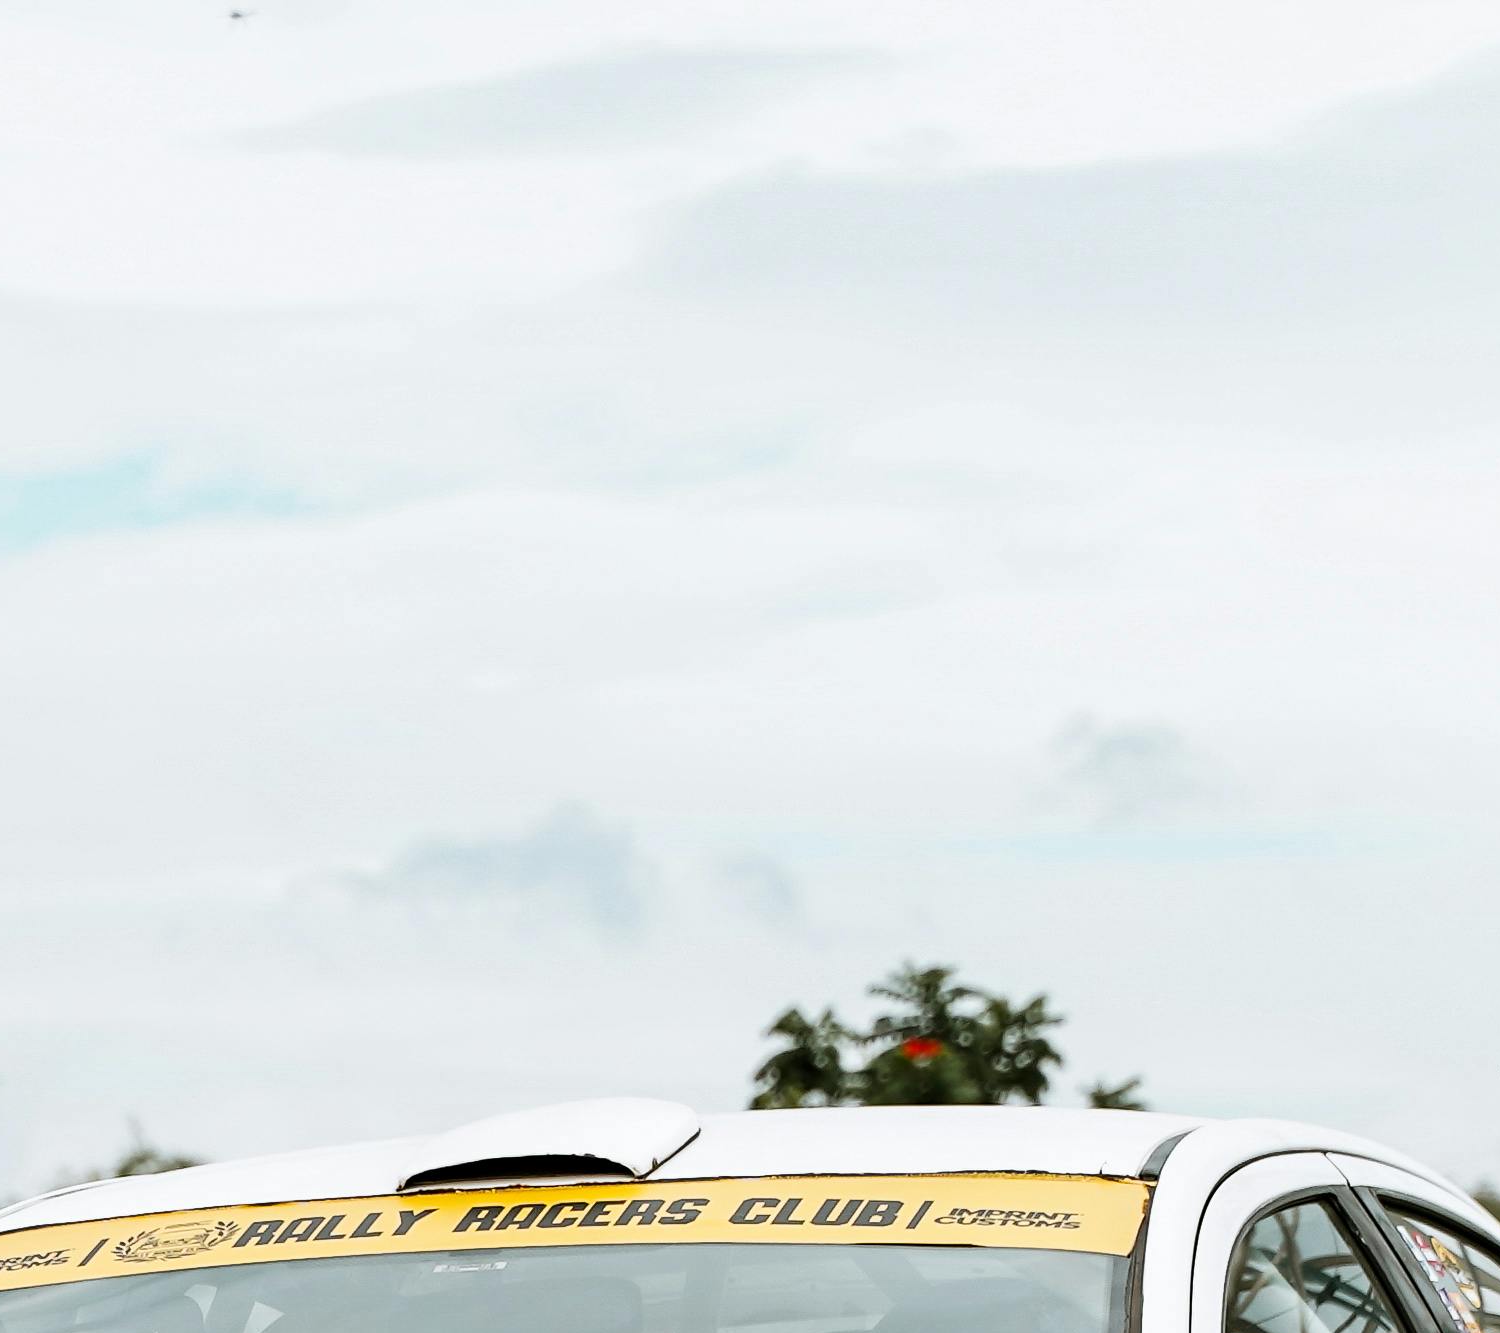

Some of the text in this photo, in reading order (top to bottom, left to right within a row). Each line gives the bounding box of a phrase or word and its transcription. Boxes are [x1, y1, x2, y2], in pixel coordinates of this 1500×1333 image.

[949, 1207, 1079, 1221] IMPRINT
[231, 1197, 905, 1248] RALLY RACERS CLUB
[934, 1216, 1082, 1230] CUSTOMS
